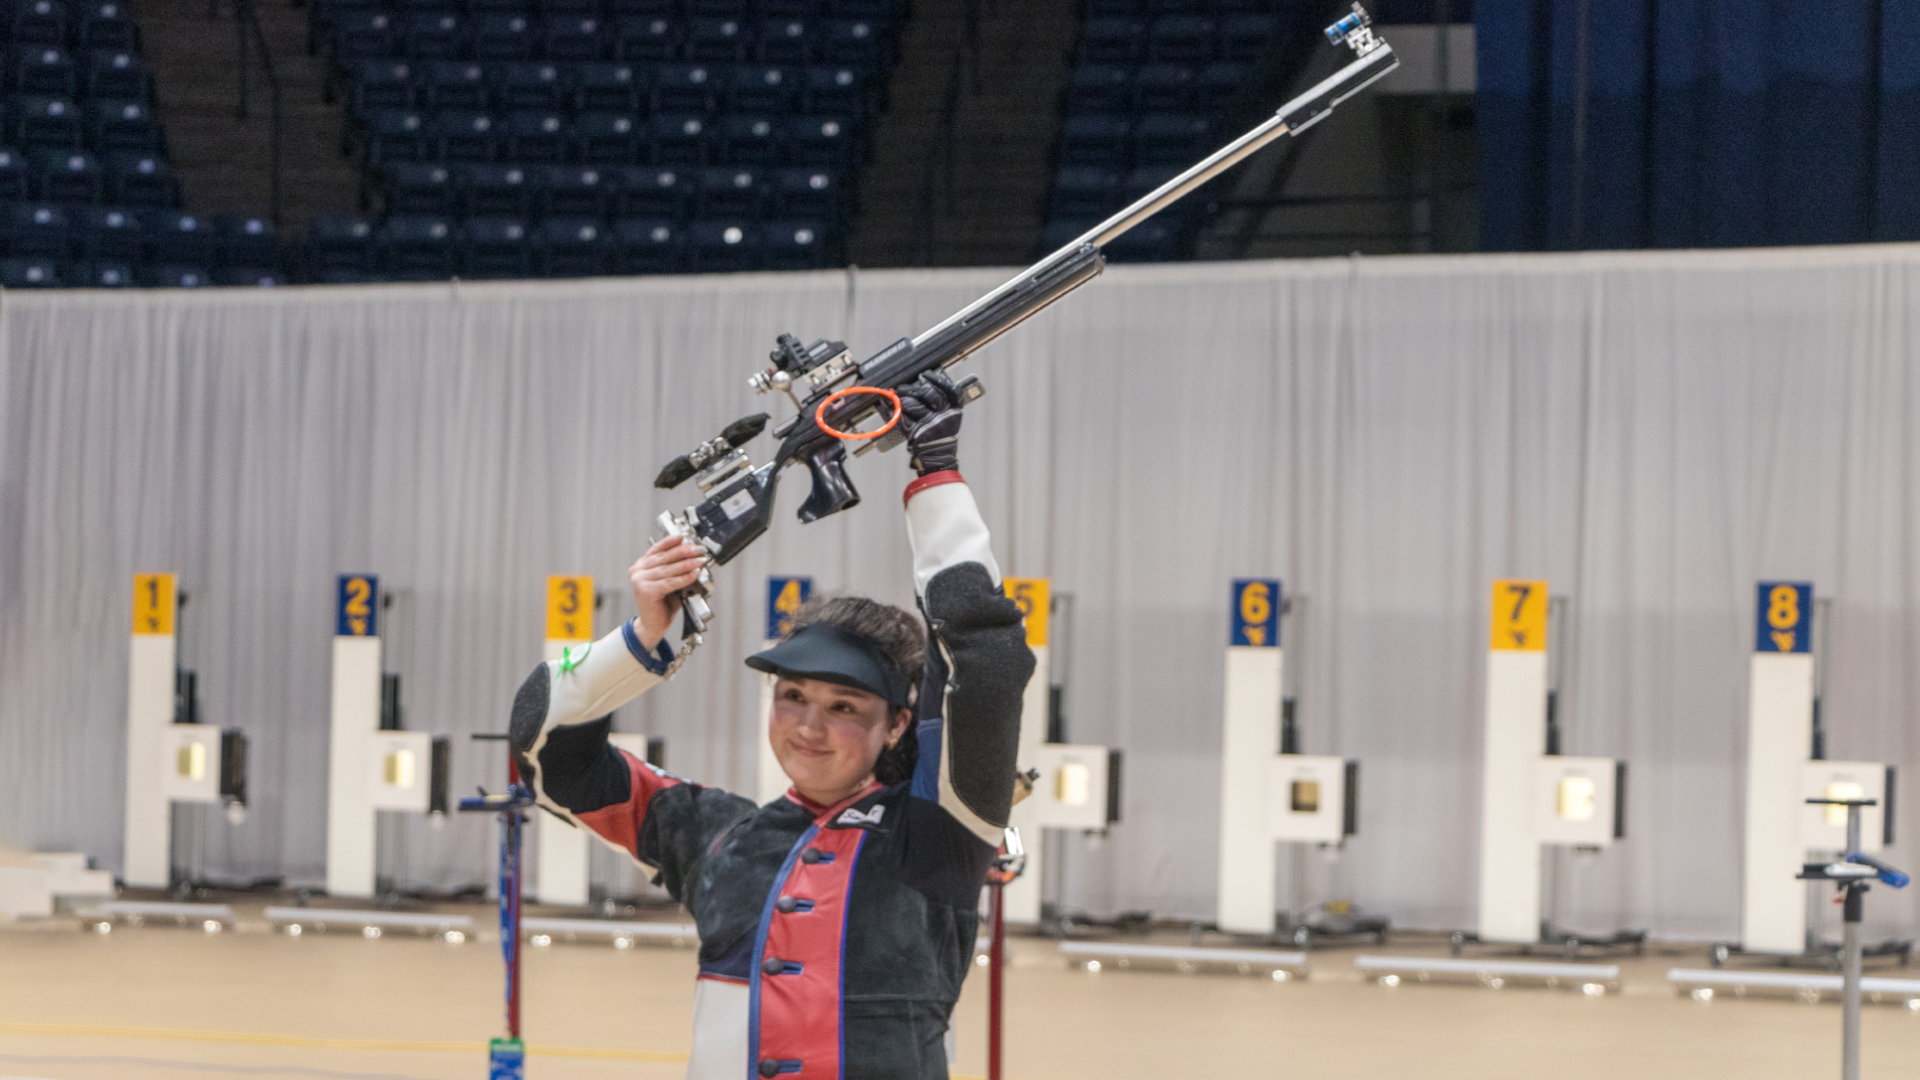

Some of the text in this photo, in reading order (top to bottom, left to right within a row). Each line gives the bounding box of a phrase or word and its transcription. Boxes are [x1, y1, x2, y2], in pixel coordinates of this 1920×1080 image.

[147, 578, 160, 610] 1
[345, 578, 371, 616] 2
[559, 580, 580, 614] 3
[775, 578, 803, 617] 4
[1013, 583, 1035, 618] 5
[1240, 582, 1271, 625] 6
[1507, 585, 1531, 622] 7
[1768, 585, 1799, 630] 8
